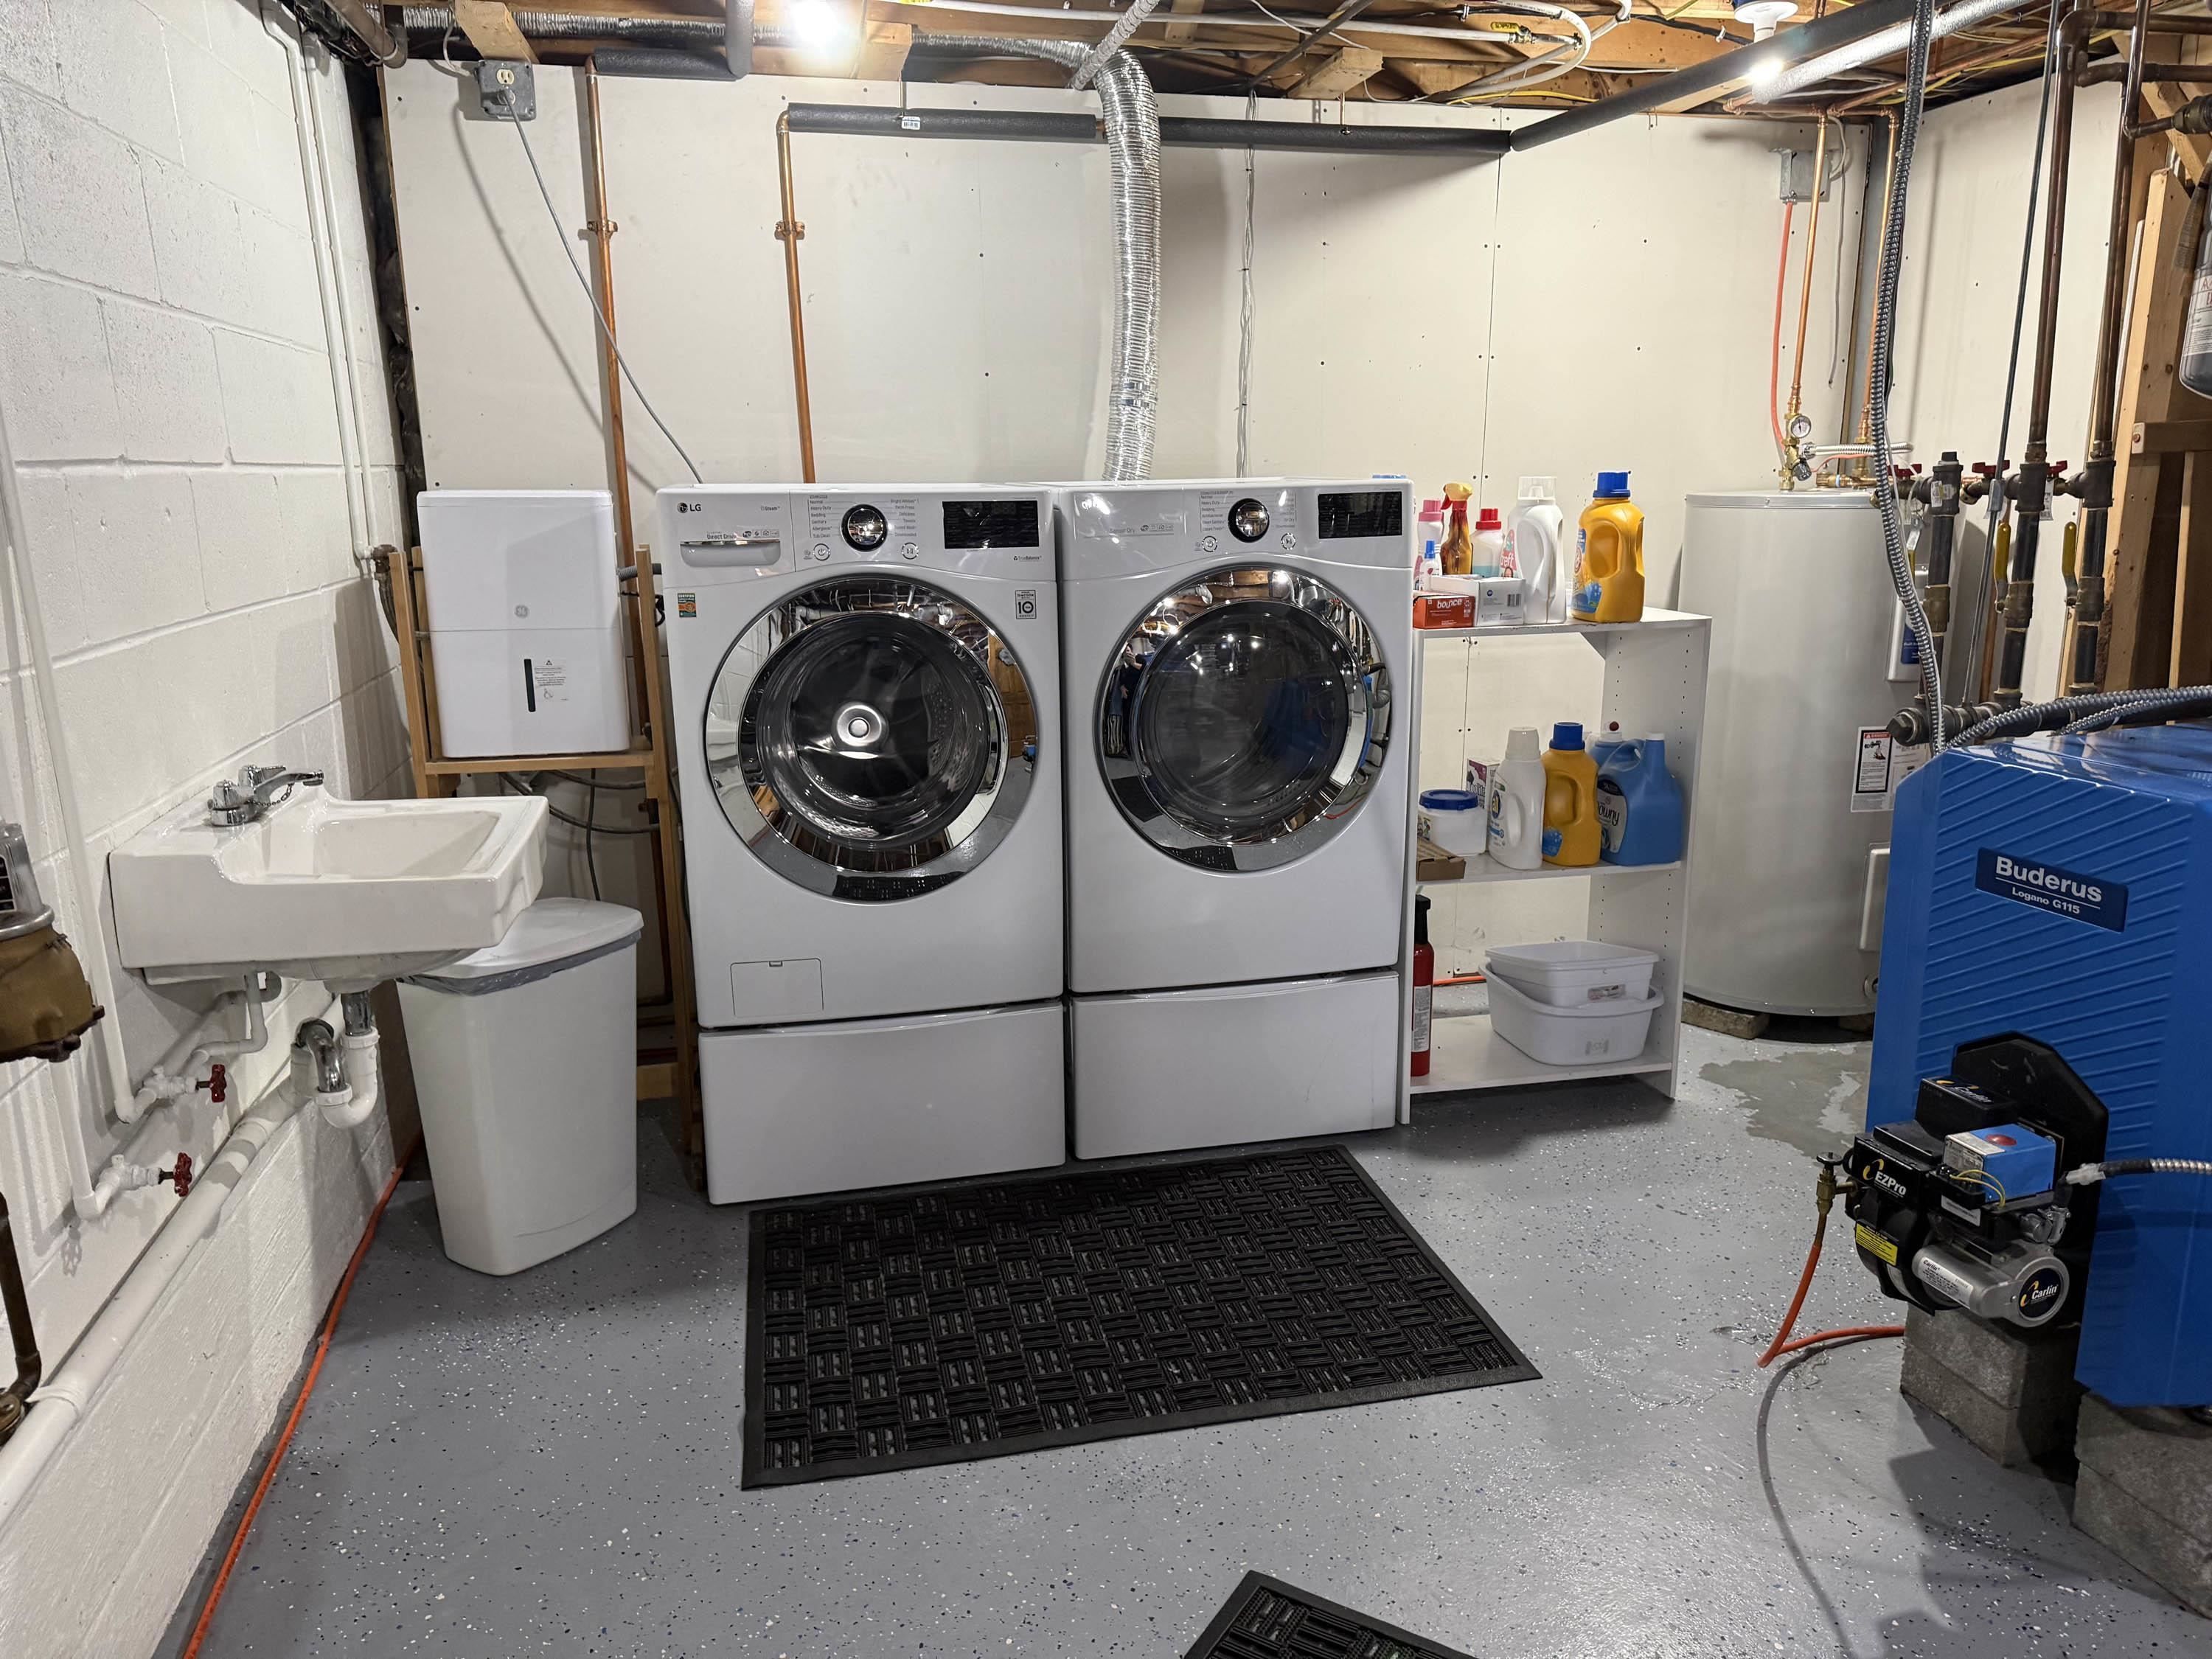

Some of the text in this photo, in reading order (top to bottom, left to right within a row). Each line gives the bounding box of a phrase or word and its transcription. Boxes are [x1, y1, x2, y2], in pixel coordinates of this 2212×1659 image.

[689, 504, 701, 512] LG
[1437, 599, 1463, 608] bounce
[1597, 801, 1620, 827] owny
[1995, 855, 2102, 902] Buderus
[2011, 886, 2081, 914] Logano G115
[1874, 1170, 1907, 1196] EZPro
[2031, 1284, 2058, 1300] Carlin
